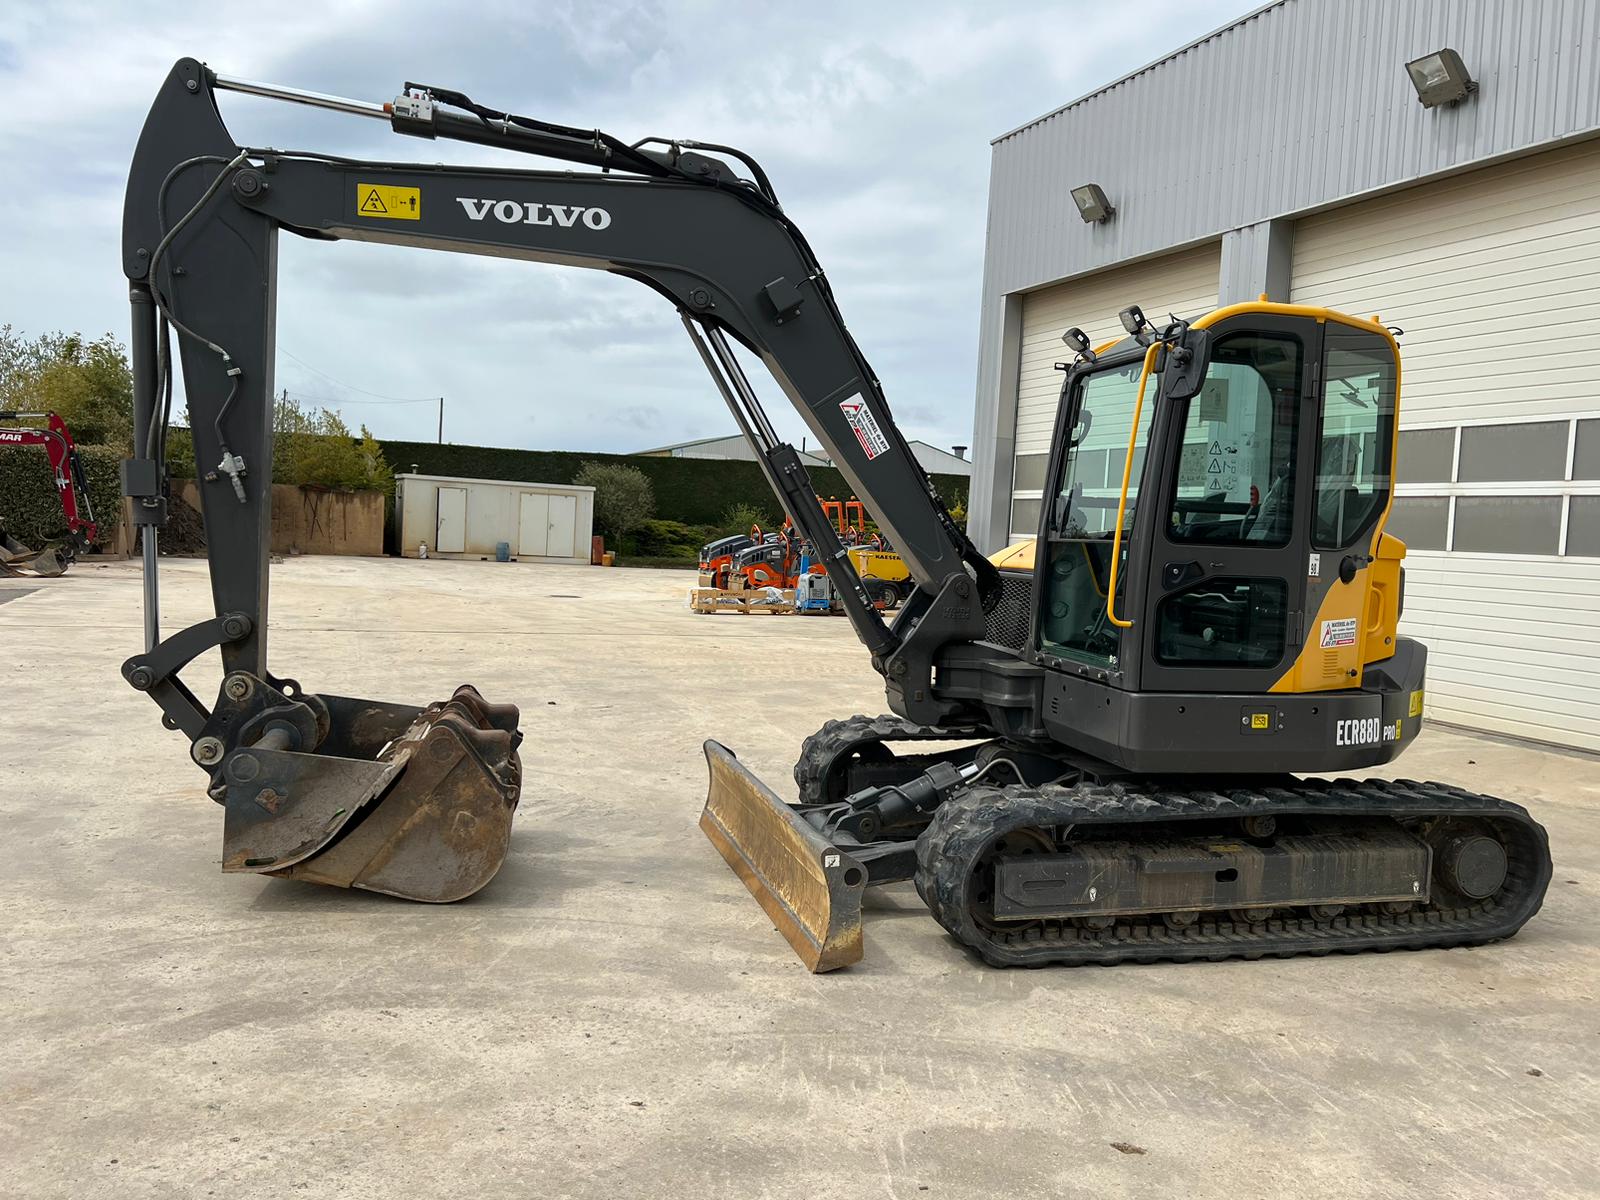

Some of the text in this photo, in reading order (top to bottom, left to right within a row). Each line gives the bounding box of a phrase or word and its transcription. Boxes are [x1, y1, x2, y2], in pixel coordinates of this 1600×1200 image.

[456, 197, 612, 231] VOLVO
[1336, 717, 1380, 746] ECR88D
[1383, 724, 1396, 741] PRO
